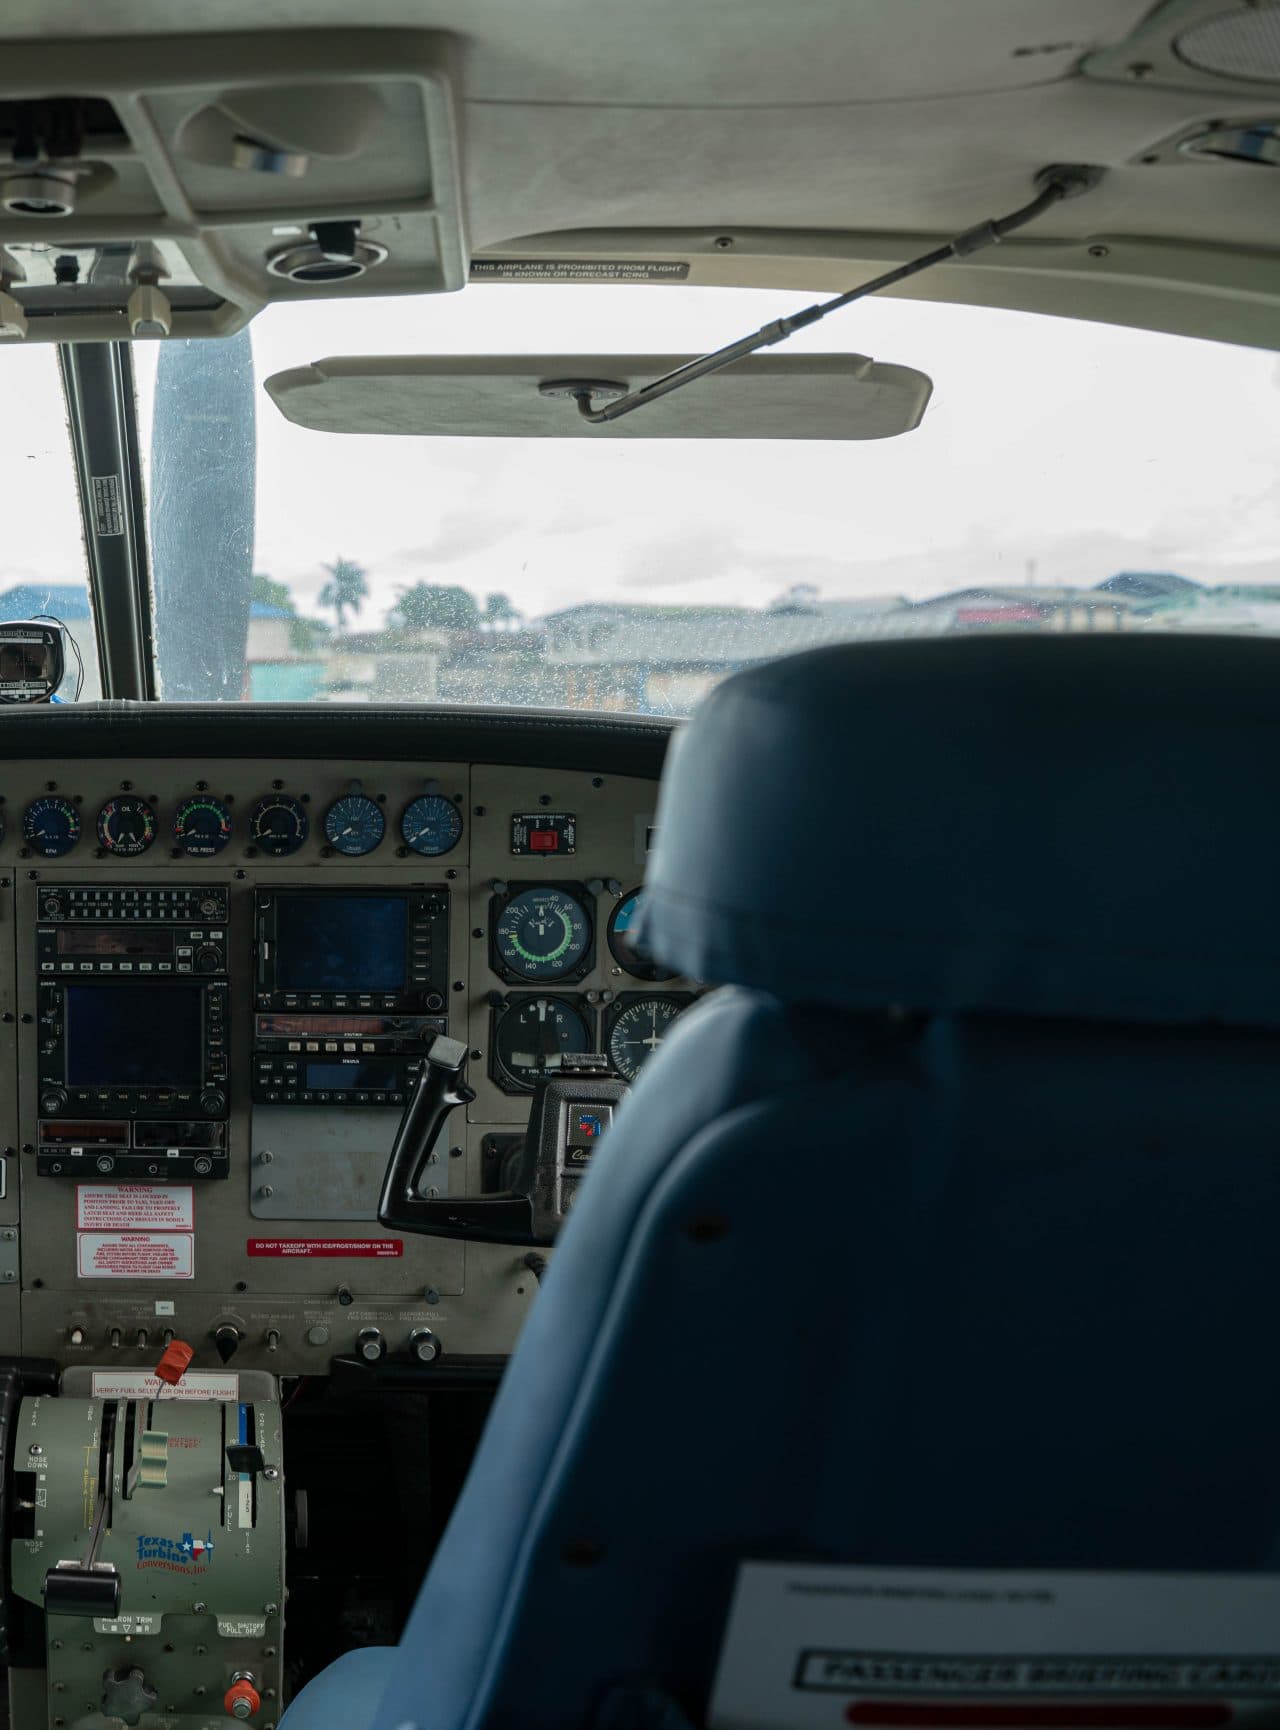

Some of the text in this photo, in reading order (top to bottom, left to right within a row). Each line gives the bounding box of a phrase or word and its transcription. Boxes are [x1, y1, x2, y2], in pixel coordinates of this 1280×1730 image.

[557, 264, 610, 272] PROHIBITED
[613, 264, 645, 272] FROM
[569, 271, 620, 279] FORECAST
[556, 1015, 563, 1023] R
[136, 1535, 174, 1549] Texas
[137, 1548, 188, 1563] Turbine
